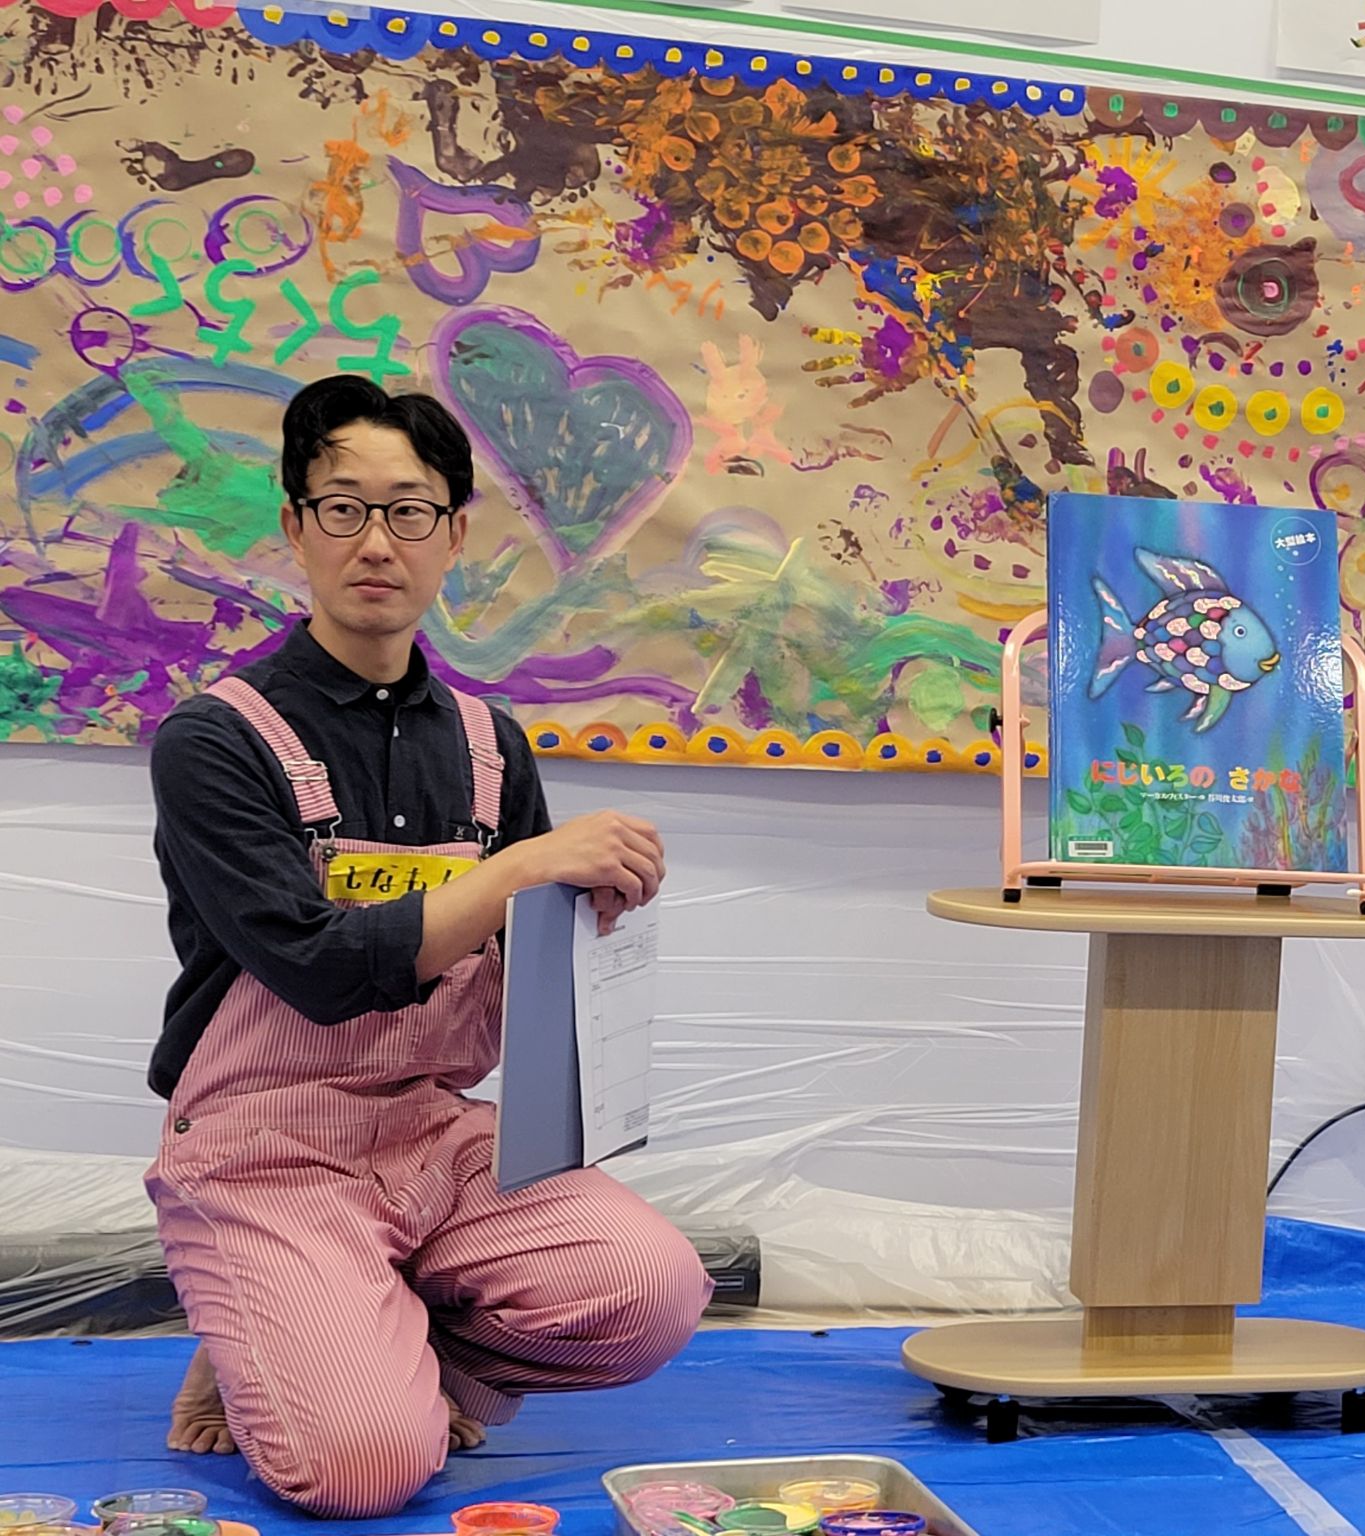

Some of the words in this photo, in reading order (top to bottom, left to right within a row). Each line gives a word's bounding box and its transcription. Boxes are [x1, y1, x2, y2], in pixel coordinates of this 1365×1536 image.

[1091, 758, 1216, 789] にじいろの
[1228, 766, 1301, 794] さかな
